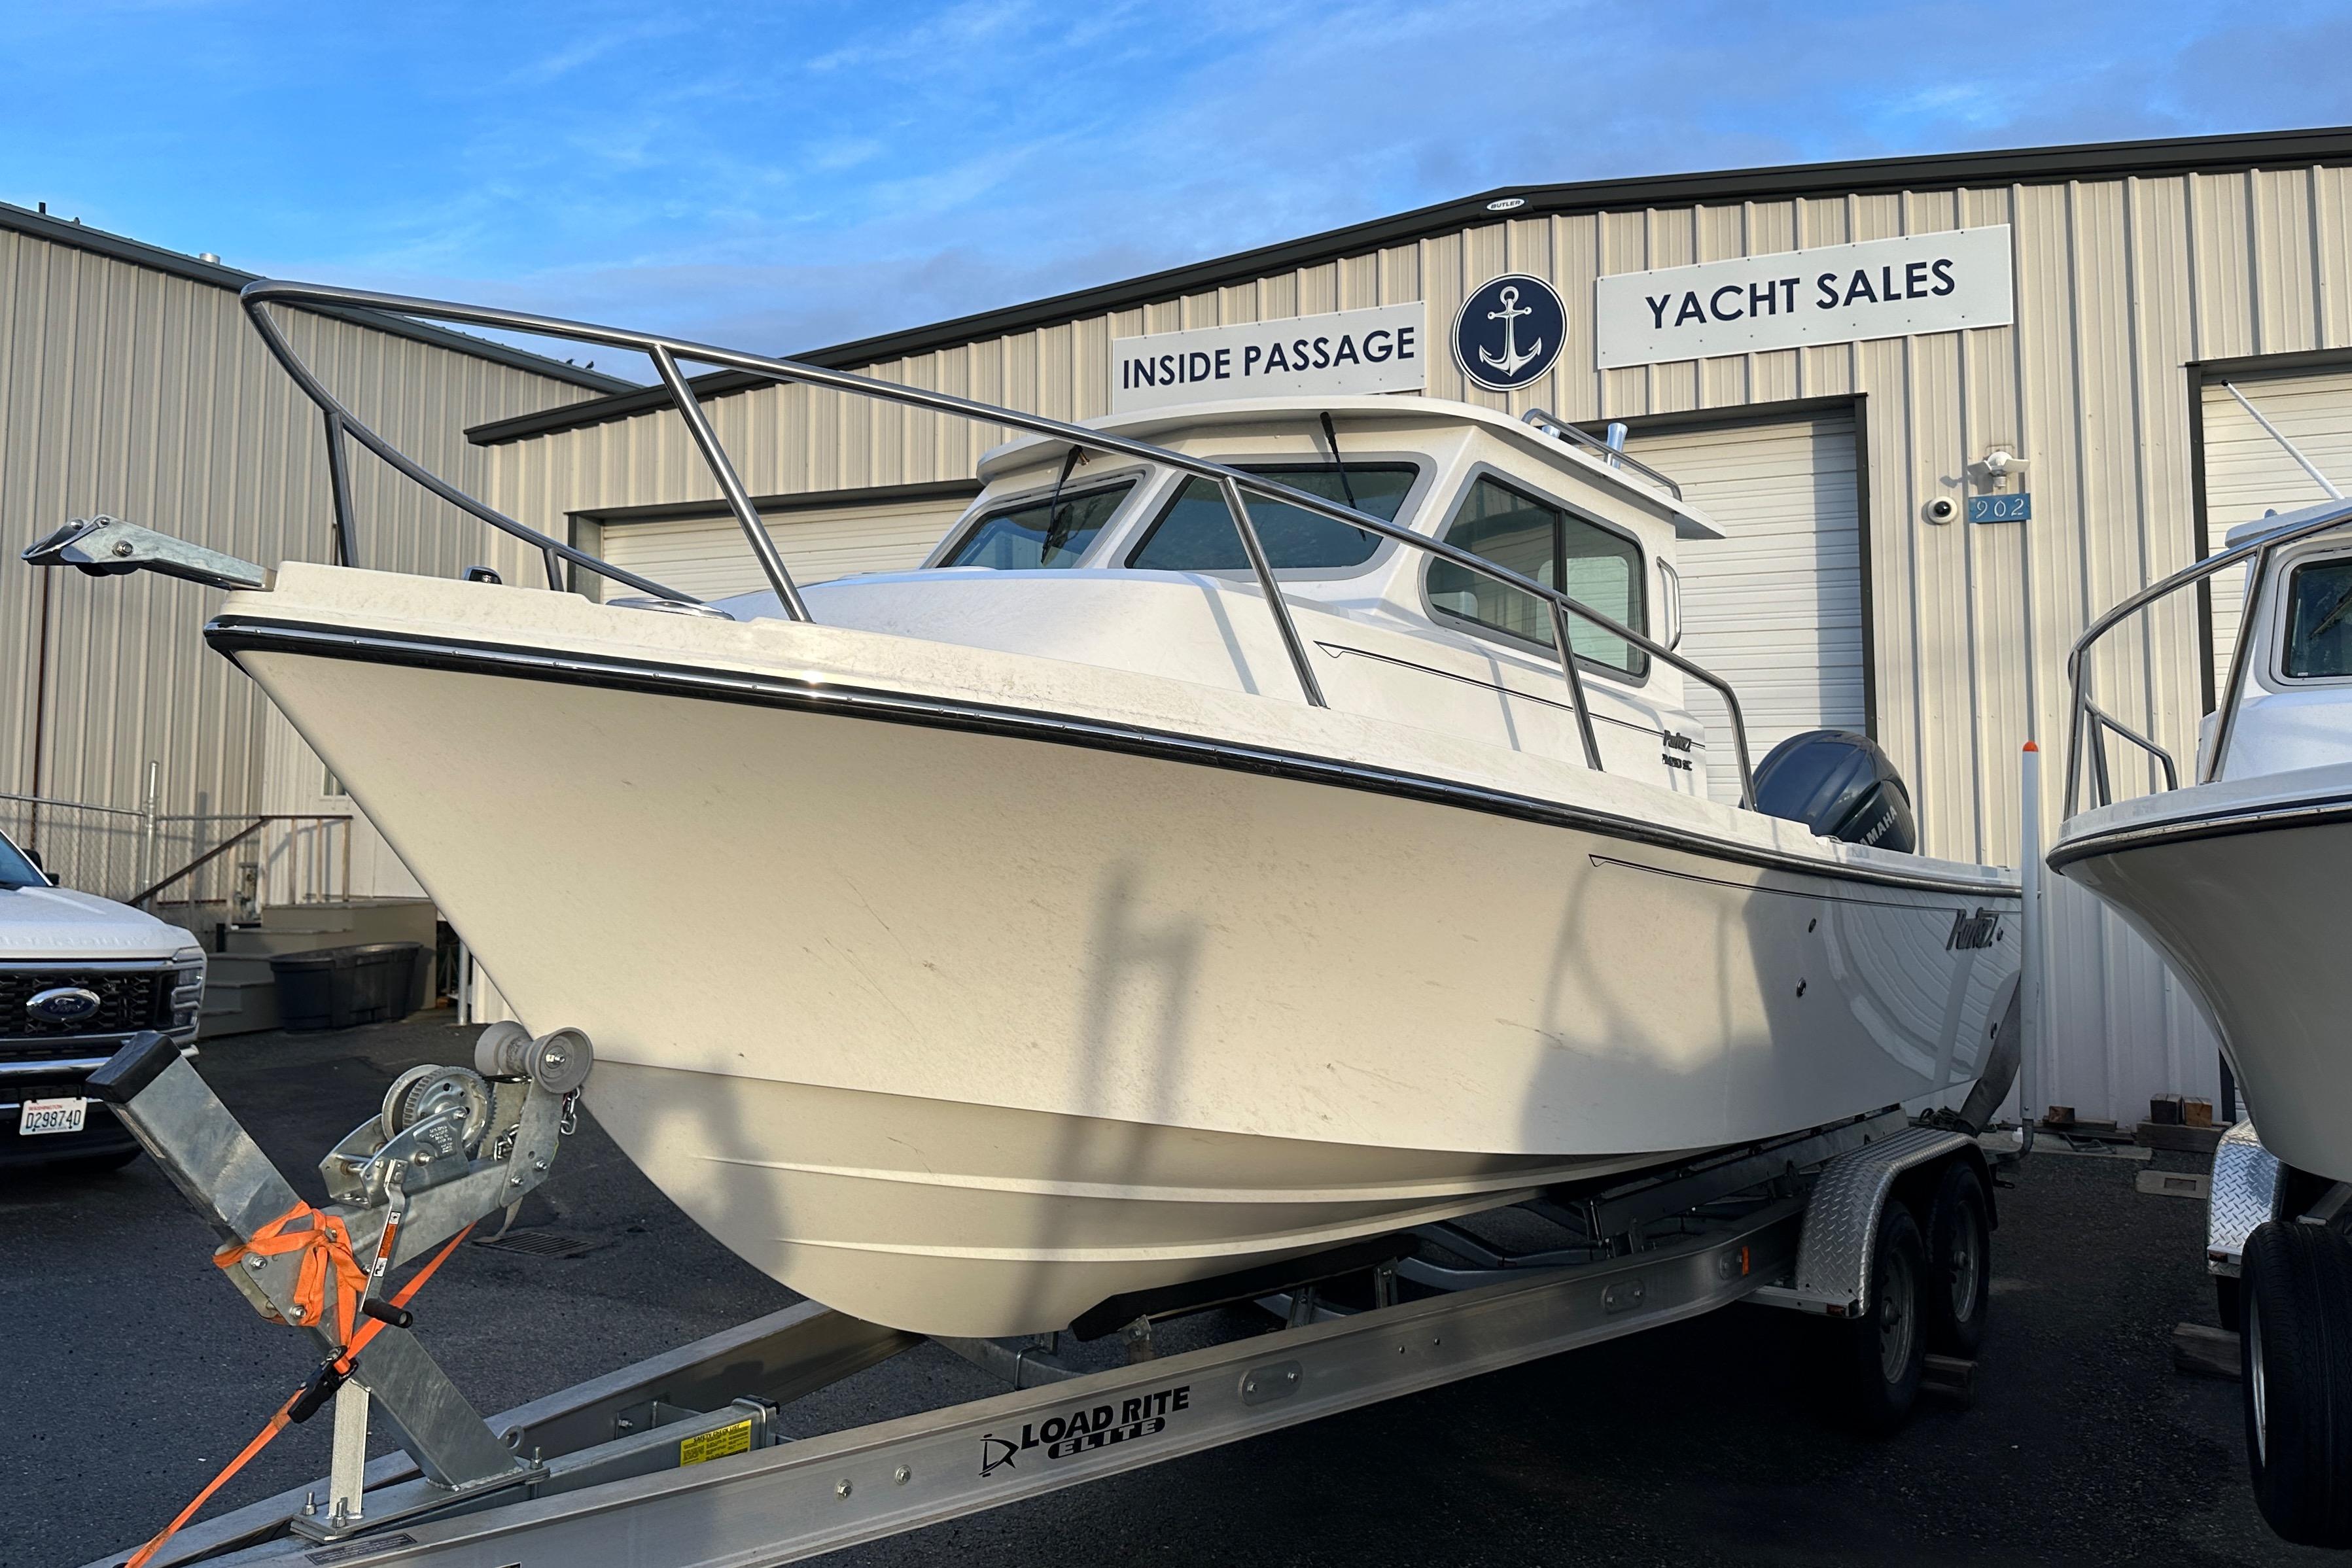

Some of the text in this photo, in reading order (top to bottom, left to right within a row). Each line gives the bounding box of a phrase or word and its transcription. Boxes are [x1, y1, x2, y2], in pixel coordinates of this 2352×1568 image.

[1490, 200, 1521, 209] BUTLER
[1645, 258, 1955, 330] YACHT SALES
[1123, 326, 1414, 389] INSIDE PASSAGE
[1975, 498, 2024, 519] 902
[1859, 805, 1898, 846] AMAHA
[26, 1109, 82, 1129] D29874D
[1021, 1385, 1190, 1450] LOAD RITE
[1058, 1418, 1157, 1457] ELITE
